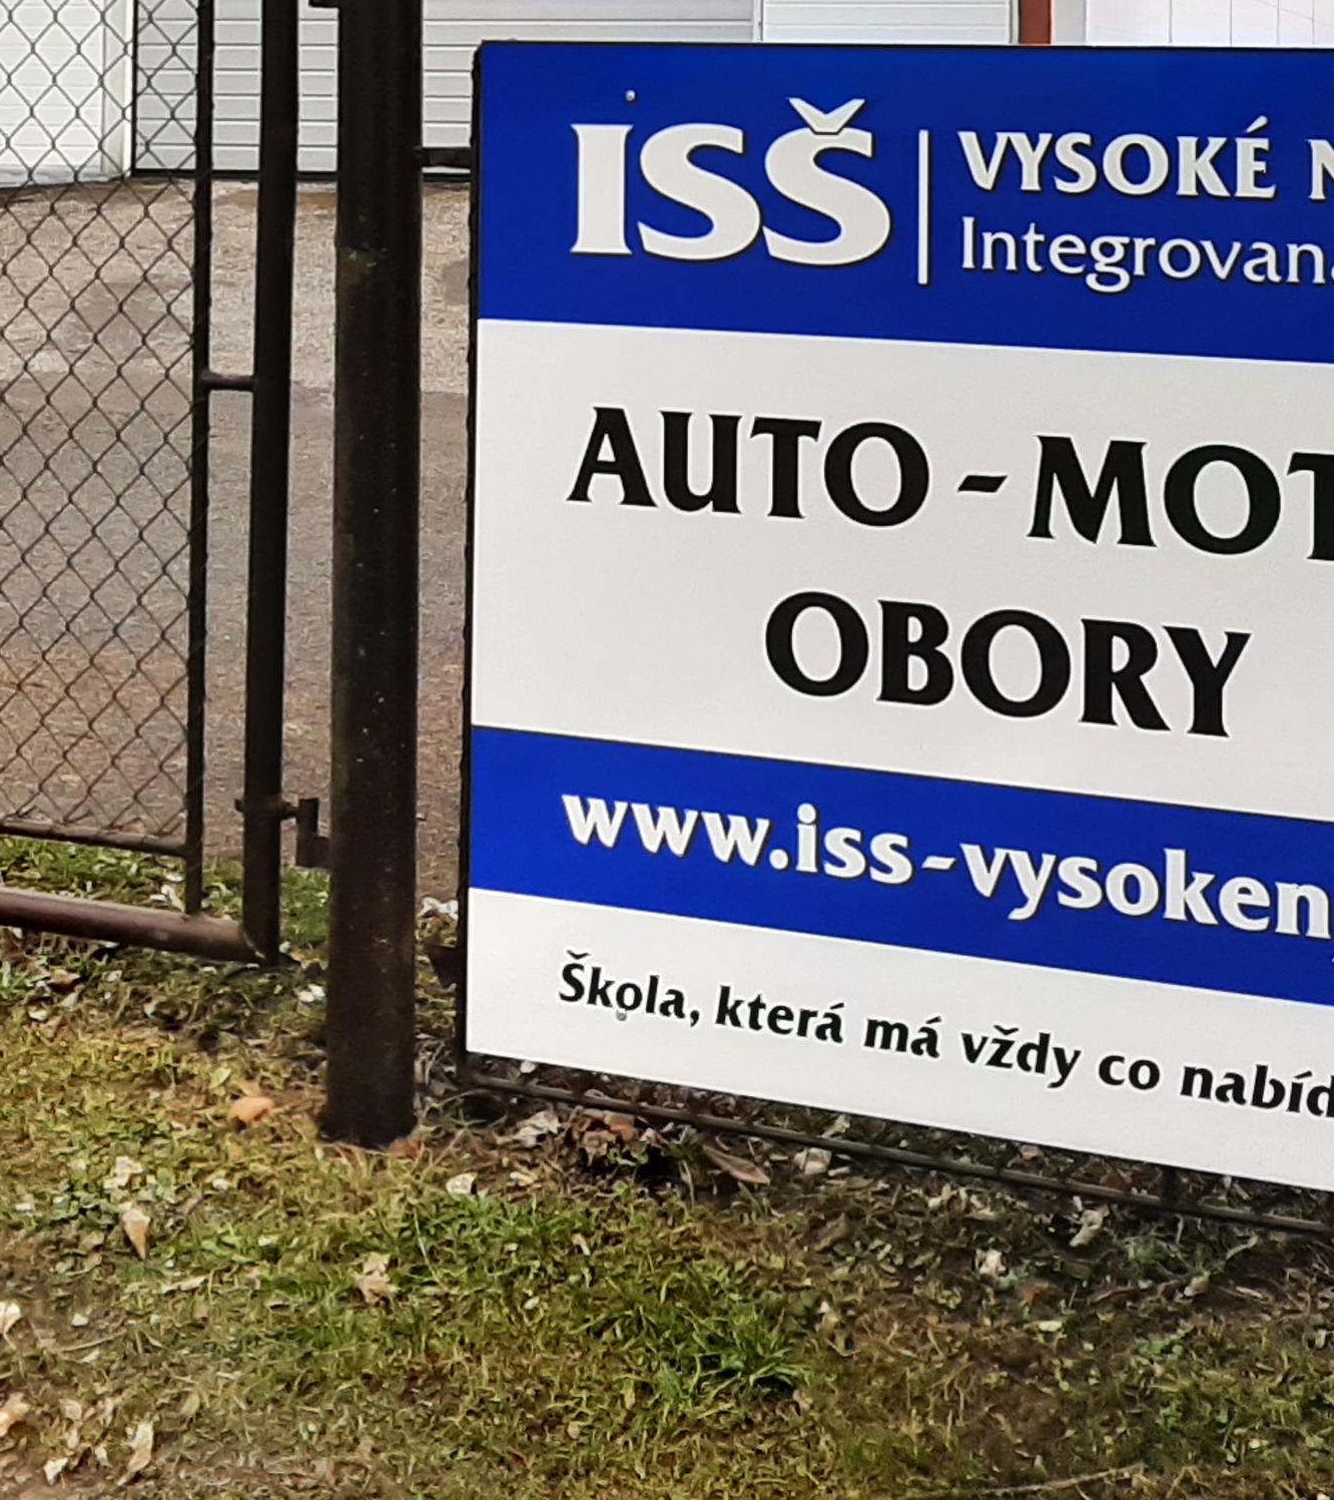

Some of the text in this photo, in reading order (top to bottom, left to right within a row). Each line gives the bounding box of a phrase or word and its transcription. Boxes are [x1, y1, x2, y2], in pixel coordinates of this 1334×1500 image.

[570, 97, 892, 266] ISŠ
[956, 116, 1278, 199] VYSOKÉ
[565, 405, 931, 528] AUTO
[764, 590, 1252, 739] OBORY
[558, 949, 701, 1028] Škola,
[714, 984, 845, 1045] která
[863, 1014, 943, 1060] má
[960, 1024, 1082, 1090] vždy
[1097, 1054, 1162, 1092] co
